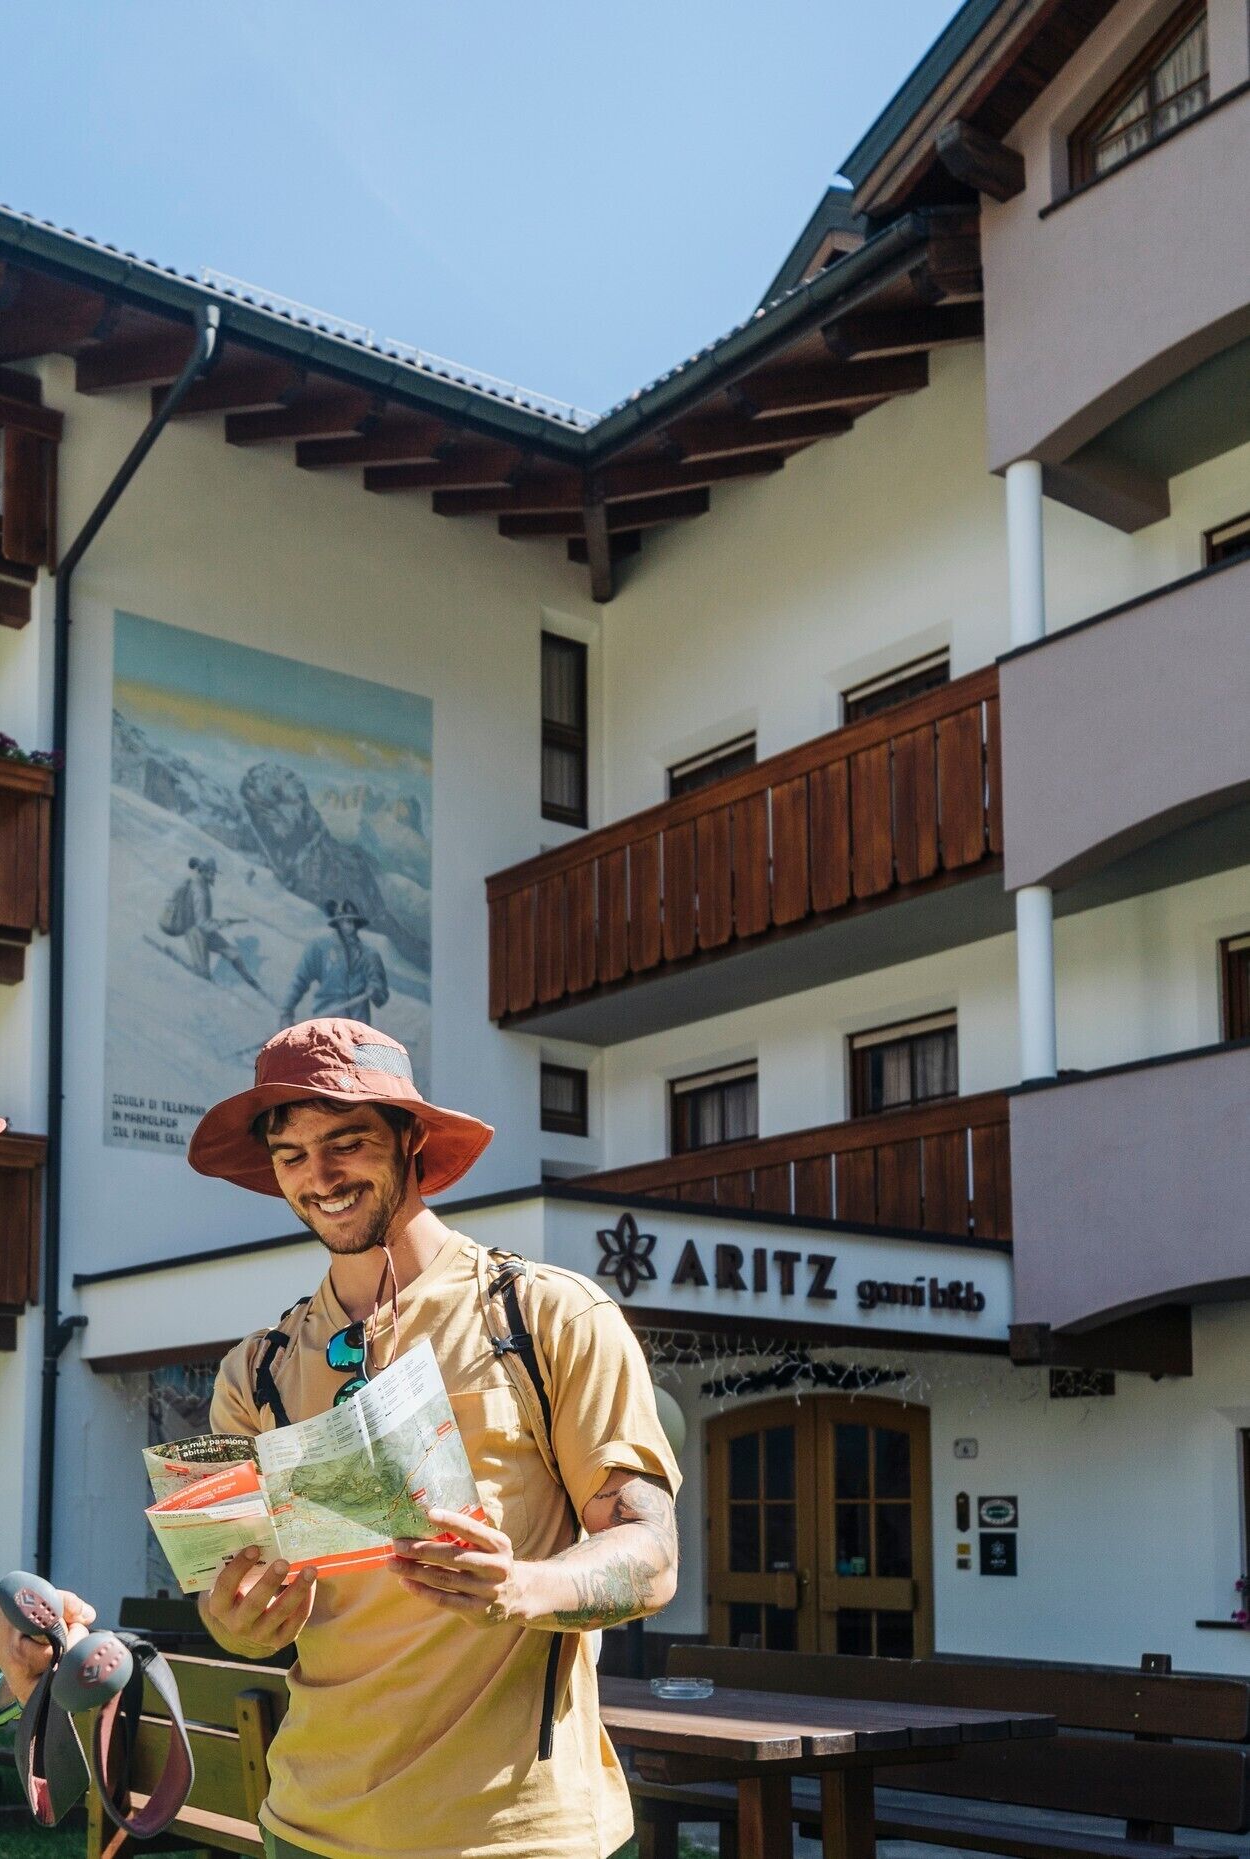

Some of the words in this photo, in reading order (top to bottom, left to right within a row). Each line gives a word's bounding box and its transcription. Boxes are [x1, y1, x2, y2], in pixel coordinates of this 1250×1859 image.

[112, 1094, 145, 1107] SCUOLA
[149, 1099, 157, 1109] DI
[112, 1111, 121, 1120] IN
[112, 1126, 129, 1137] SUL
[671, 1239, 837, 1299] ARITZ
[929, 1277, 985, 1312] b&b
[190, 1440, 207, 1448] mia
[209, 1438, 249, 1446] passione
[183, 1449, 205, 1457] abita
[208, 1446, 222, 1454] qui
